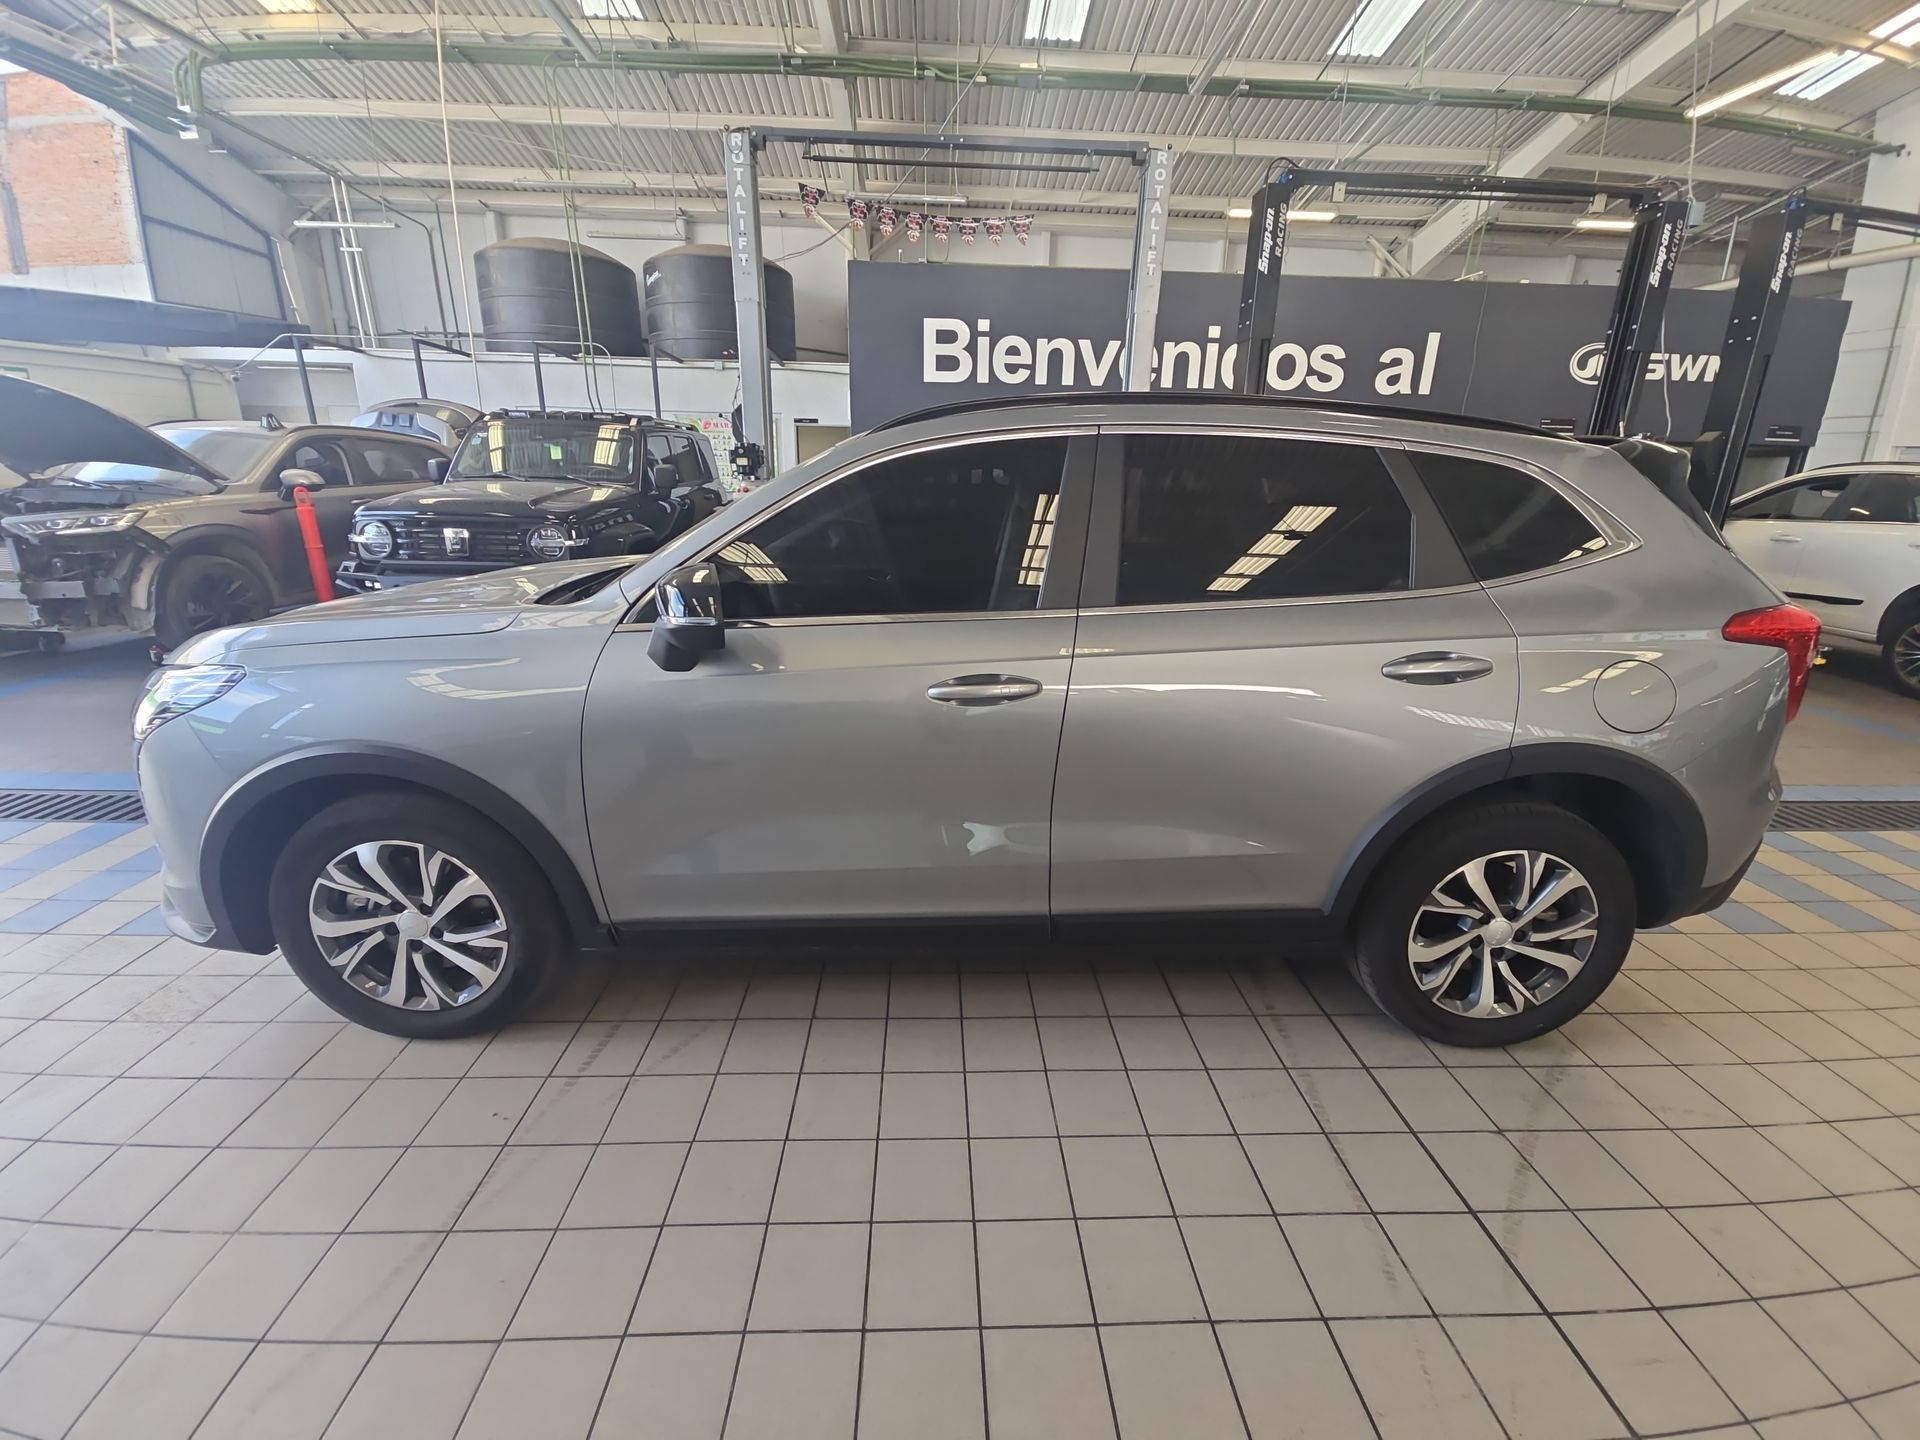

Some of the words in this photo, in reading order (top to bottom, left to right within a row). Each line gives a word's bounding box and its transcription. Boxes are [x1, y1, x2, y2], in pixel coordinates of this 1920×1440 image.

[731, 132, 749, 266] ROTALIFT
[1147, 151, 1168, 276] ROTALIFT
[1274, 202, 1287, 257] RACING
[1258, 207, 1275, 275] Snap-on
[1649, 223, 1672, 288] Snap-on
[1666, 218, 1684, 271] RACING
[1771, 231, 1793, 294] Snap-on
[1373, 331, 1442, 396] al
